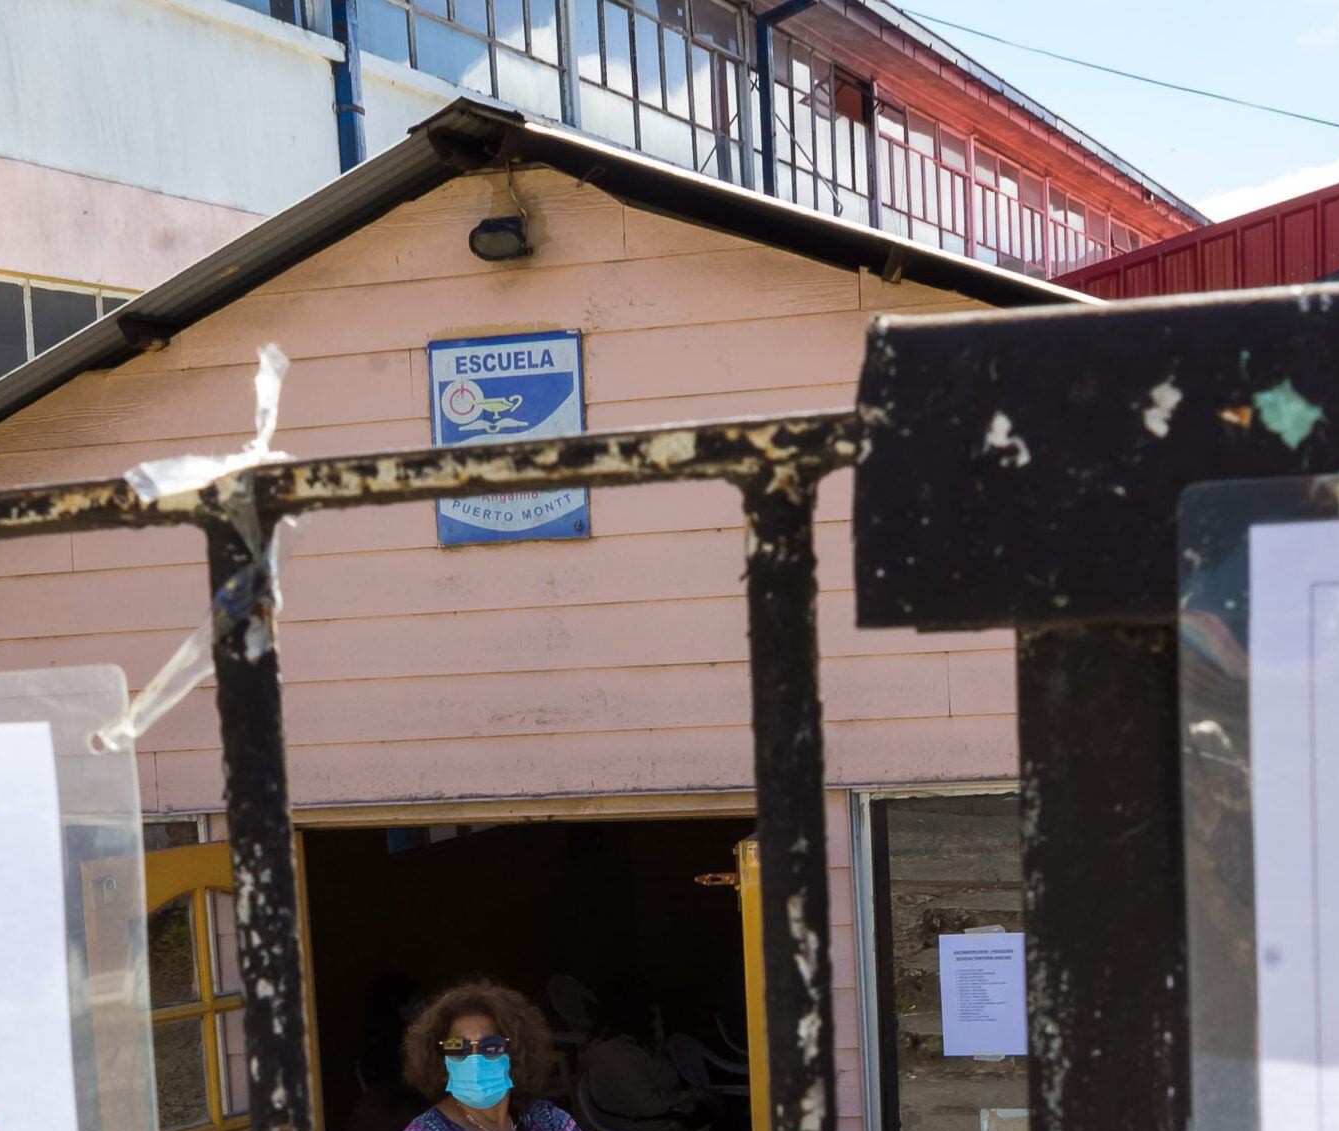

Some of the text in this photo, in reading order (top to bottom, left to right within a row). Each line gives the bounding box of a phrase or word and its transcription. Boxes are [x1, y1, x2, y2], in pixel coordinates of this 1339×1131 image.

[455, 349, 554, 374] ESCUELA
[451, 493, 572, 521] PUERTO MONTT
